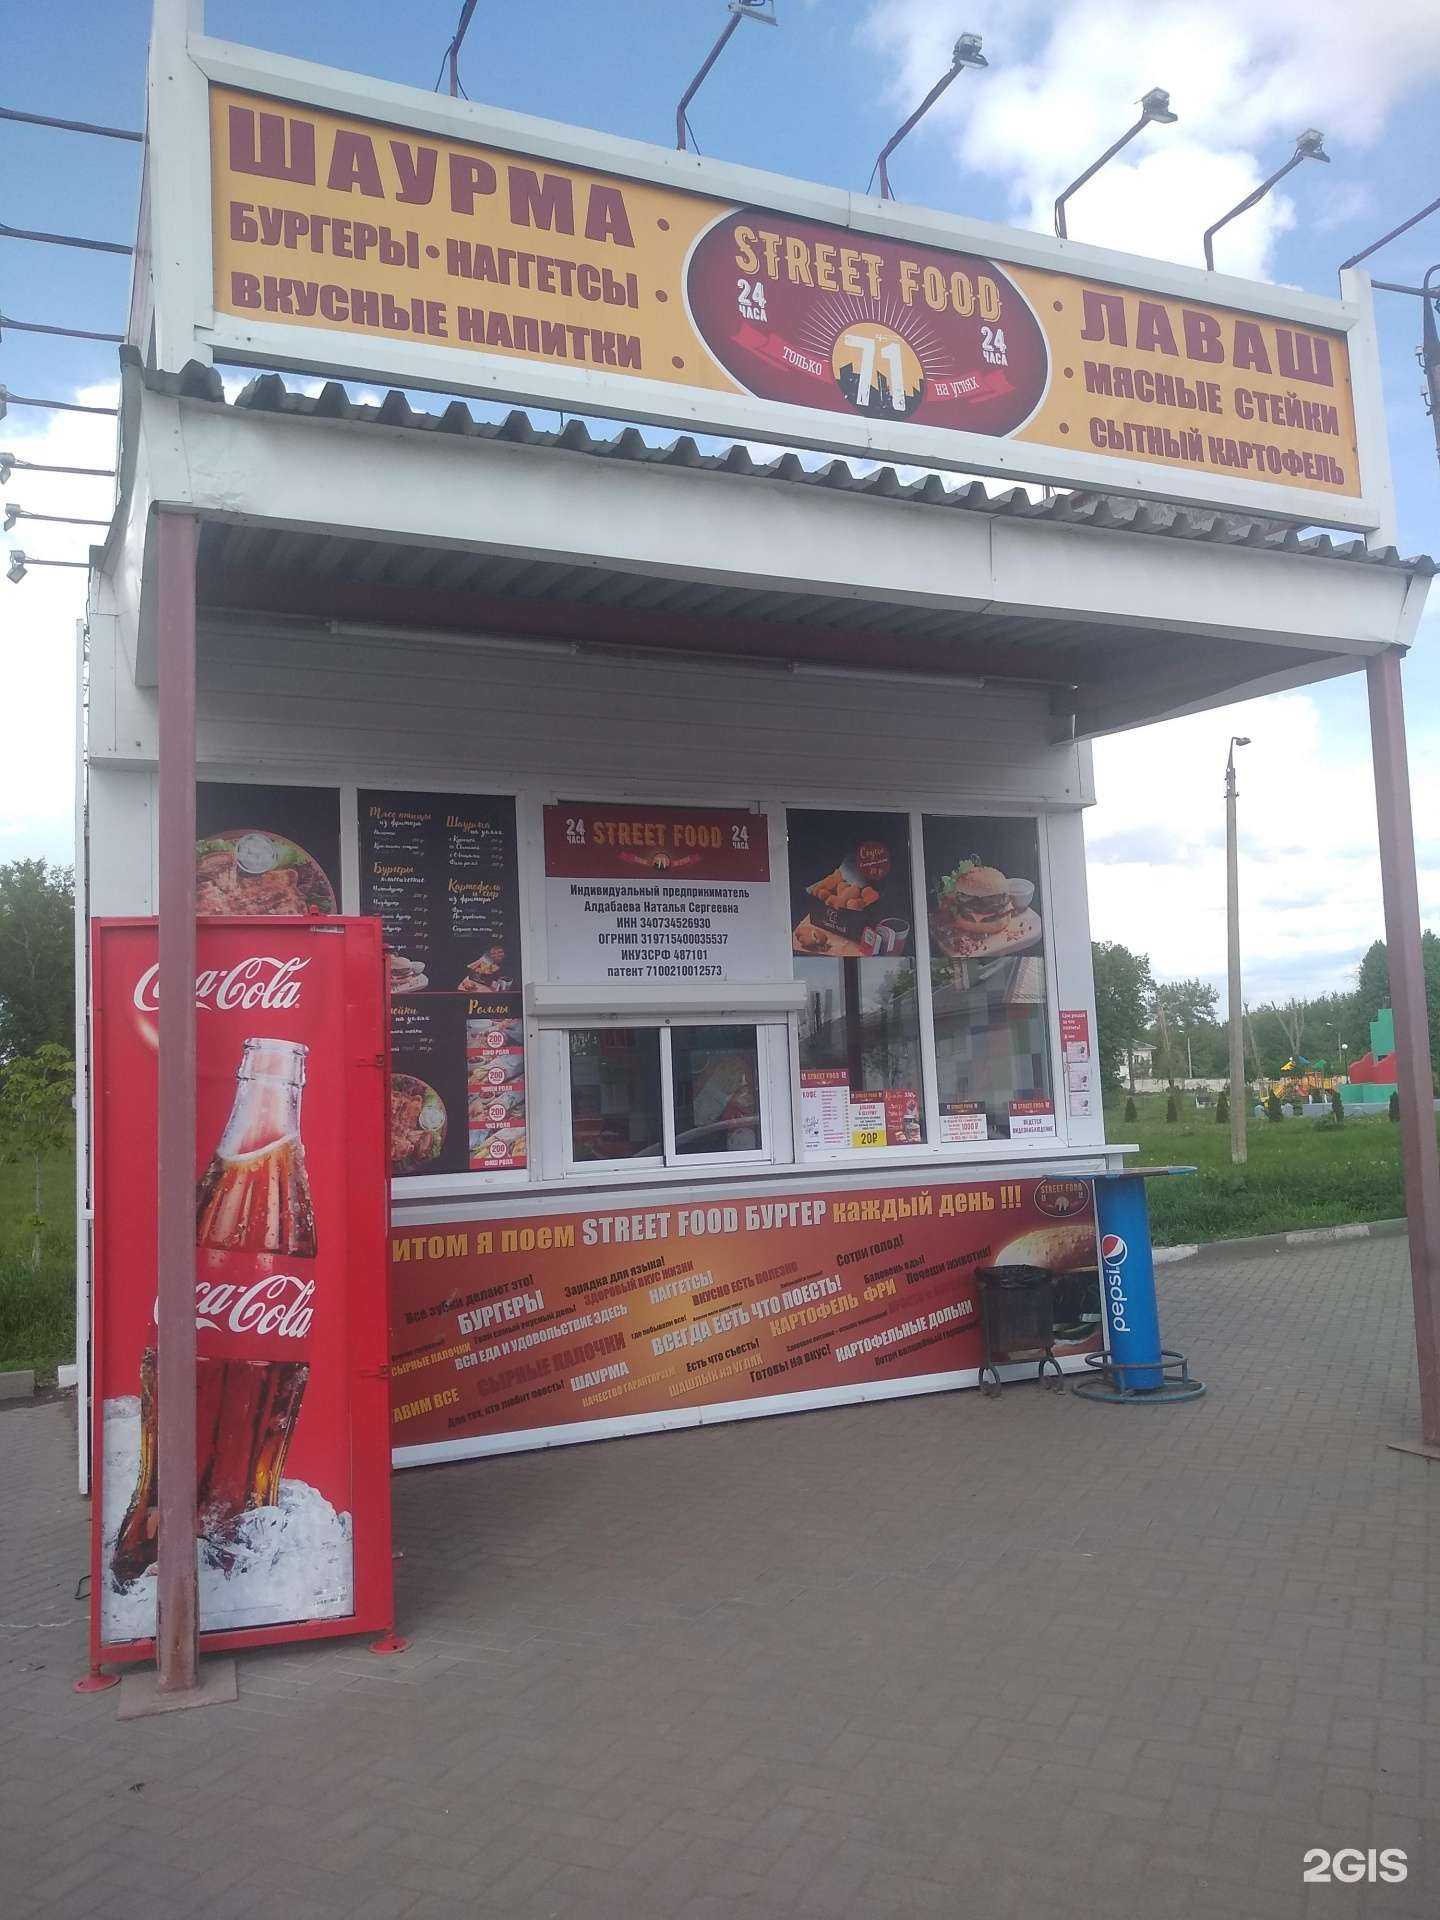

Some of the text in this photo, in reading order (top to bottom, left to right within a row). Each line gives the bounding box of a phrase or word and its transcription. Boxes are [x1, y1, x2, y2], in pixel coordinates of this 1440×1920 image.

[229, 105, 635, 248] ШАУРМА
[230, 201, 639, 309] БУРГЕРЫ НАГГЕТСЫ
[733, 225, 1003, 323] STREET FOOD
[737, 278, 765, 306] 24
[230, 271, 642, 370] ВКУСНЫЕ НАПИТКИ
[738, 304, 768, 322] ЧАСА
[980, 326, 1007, 354] 24
[1080, 289, 1334, 388] ЛАВАШ
[844, 334, 906, 411] 71
[982, 351, 1009, 367] ЧАСА
[1084, 360, 1339, 436] МЯСНЫЕ СТЕЙКИ
[1089, 416, 1345, 486] СЫТНЫЙ КАРТОФЕЛЬ
[566, 818, 586, 836] 24
[567, 835, 586, 845] ЧАСА
[593, 822, 724, 849] STREET FOOD
[731, 825, 749, 842] 24
[570, 884, 750, 899] Индивидуальный предприниматель
[584, 901, 739, 915] Алдабаева Наталья Сергеевна
[598, 934, 638, 944] ОГРНИП
[616, 918, 711, 929] ИНН 340734526930
[133, 956, 311, 1012] Ca-Cola
[607, 966, 643, 977] патент
[582, 1212, 671, 1246] STREET
[678, 1207, 738, 1237] FOOD
[745, 1200, 827, 1231] БУРГЕР
[832, 1190, 933, 1223] каждый
[938, 1189, 995, 1217] день
[1000, 1185, 1022, 1209] !!!
[836, 1248, 869, 1267] Сотри
[564, 1256, 665, 1298] Зарядка для языка!
[649, 1270, 715, 1305] НАГГЕТСЫ
[692, 1285, 731, 1307] ВКУСНО
[731, 1276, 755, 1292] ЕСТЬ
[153, 1274, 316, 1339] ca-Cola
[457, 1289, 545, 1335] БУРГЕРЫ
[652, 1320, 712, 1357] ВСЕГДА
[714, 1306, 751, 1334] ЕСТЬ
[751, 1295, 782, 1320] ЧТО
[783, 1274, 842, 1310] ПОЕСТЬ!
[769, 1294, 859, 1337] КАРТОФЕЛЬ
[863, 1278, 897, 1303] ФРИ
[1106, 1268, 1130, 1332] pepsi
[511, 1315, 594, 1352] УДОВОЛЬСТВИЕ
[594, 1304, 629, 1324] ЗДЕСЬ
[835, 1316, 929, 1363] КАРТОФЕЛЬНЫЕ
[928, 1299, 974, 1330] ДОЛЬКИ
[570, 1361, 630, 1392] ШАУРМА
[686, 1359, 707, 1373] Есть
[750, 1361, 789, 1383] Готовы
[790, 1357, 803, 1369] на
[434, 1388, 460, 1409] ВСЕ
